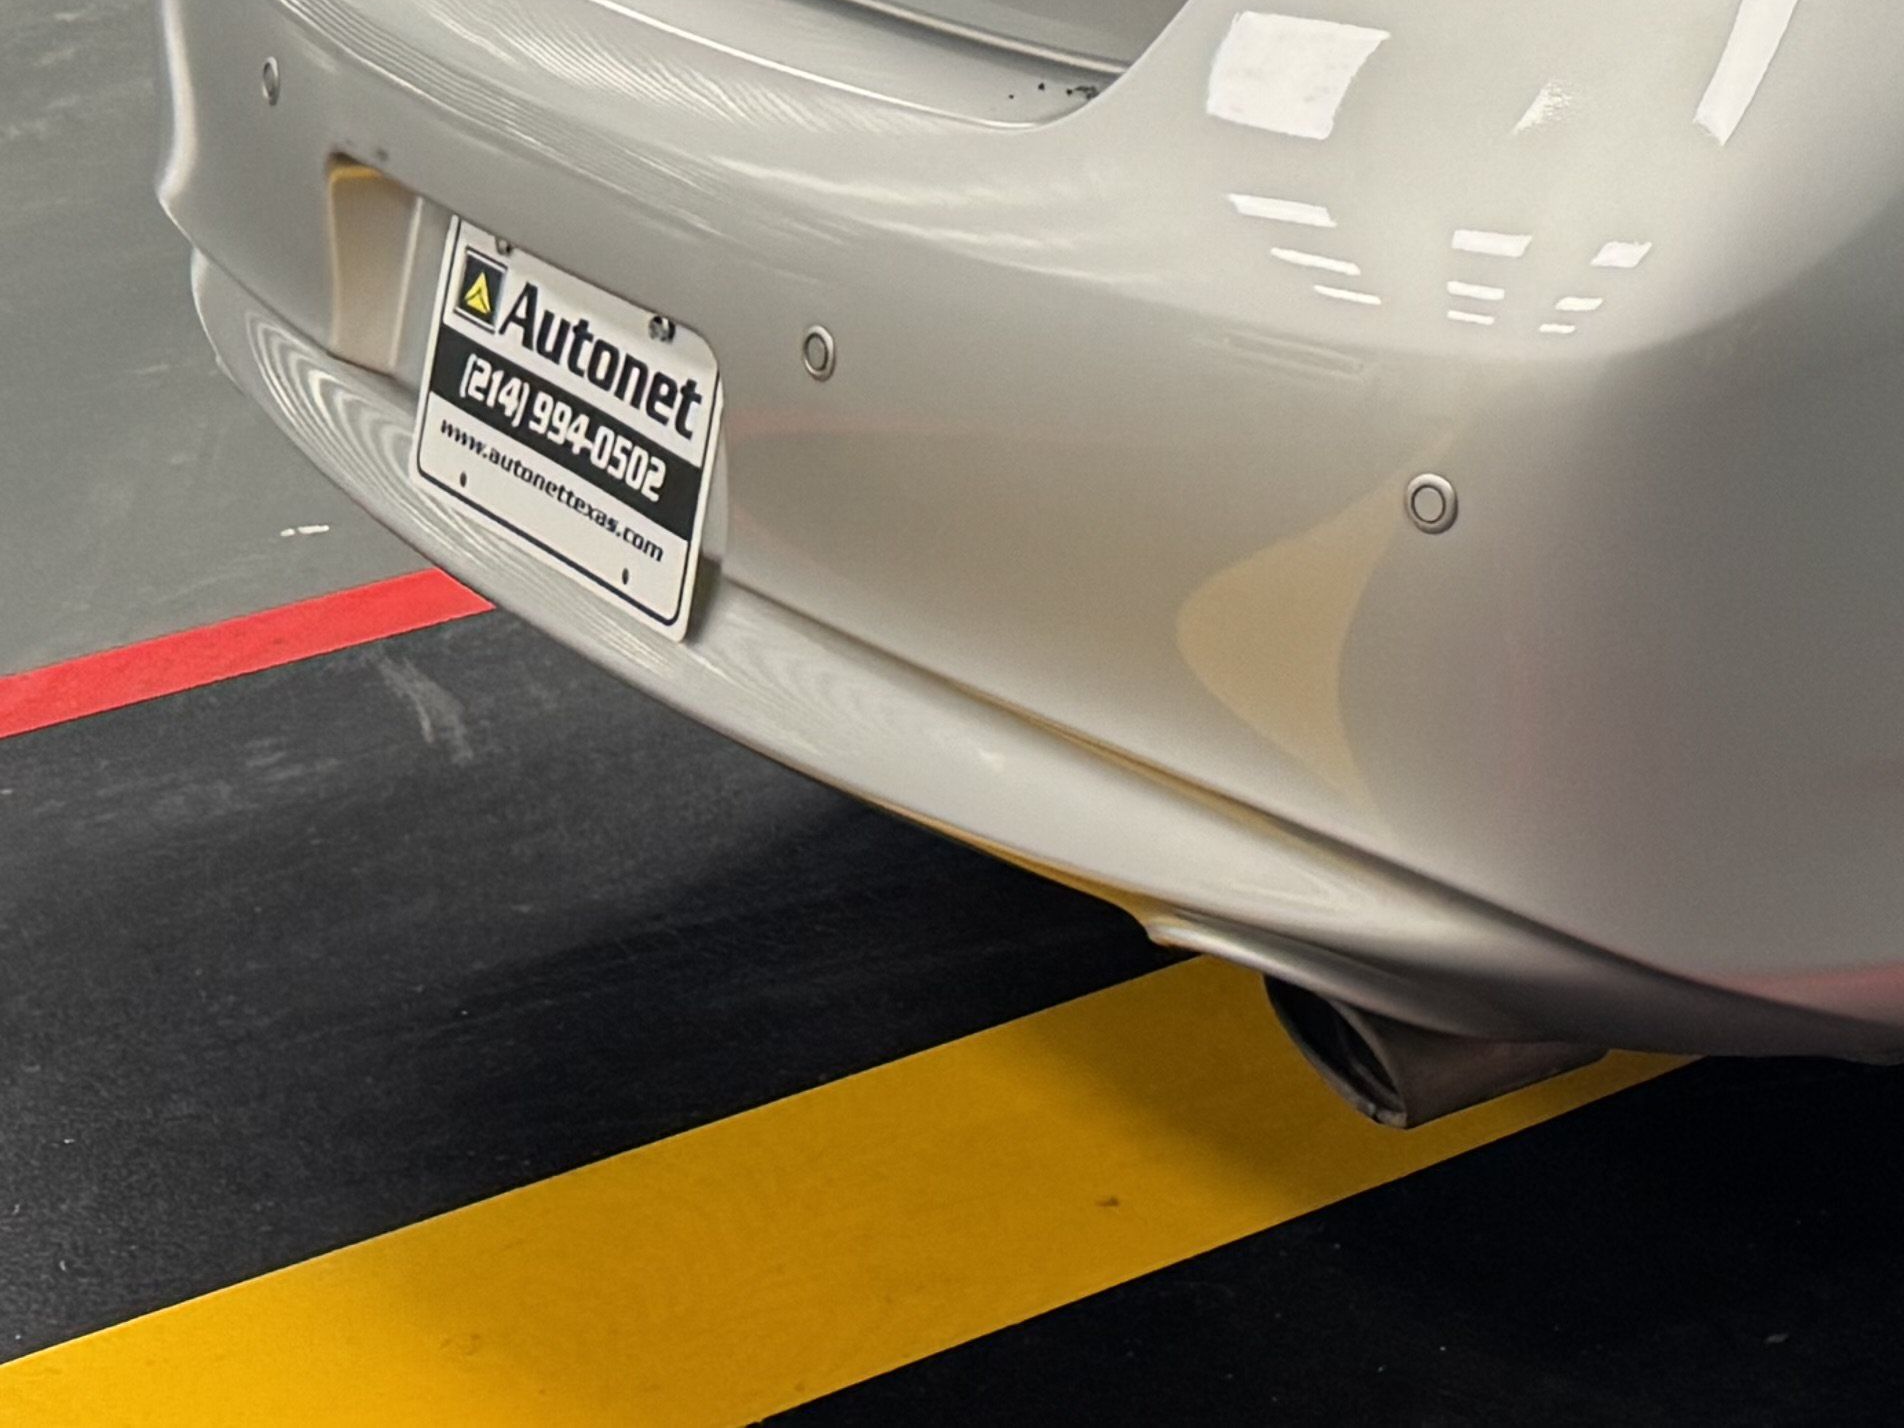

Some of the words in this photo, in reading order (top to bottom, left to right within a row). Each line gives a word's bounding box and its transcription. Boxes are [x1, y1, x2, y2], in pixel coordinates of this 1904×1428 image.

[459, 352, 532, 429] (214)
[528, 389, 667, 503] 994-0502
[500, 280, 702, 440] Autonet
[440, 417, 665, 564] www.autonettexas.com
